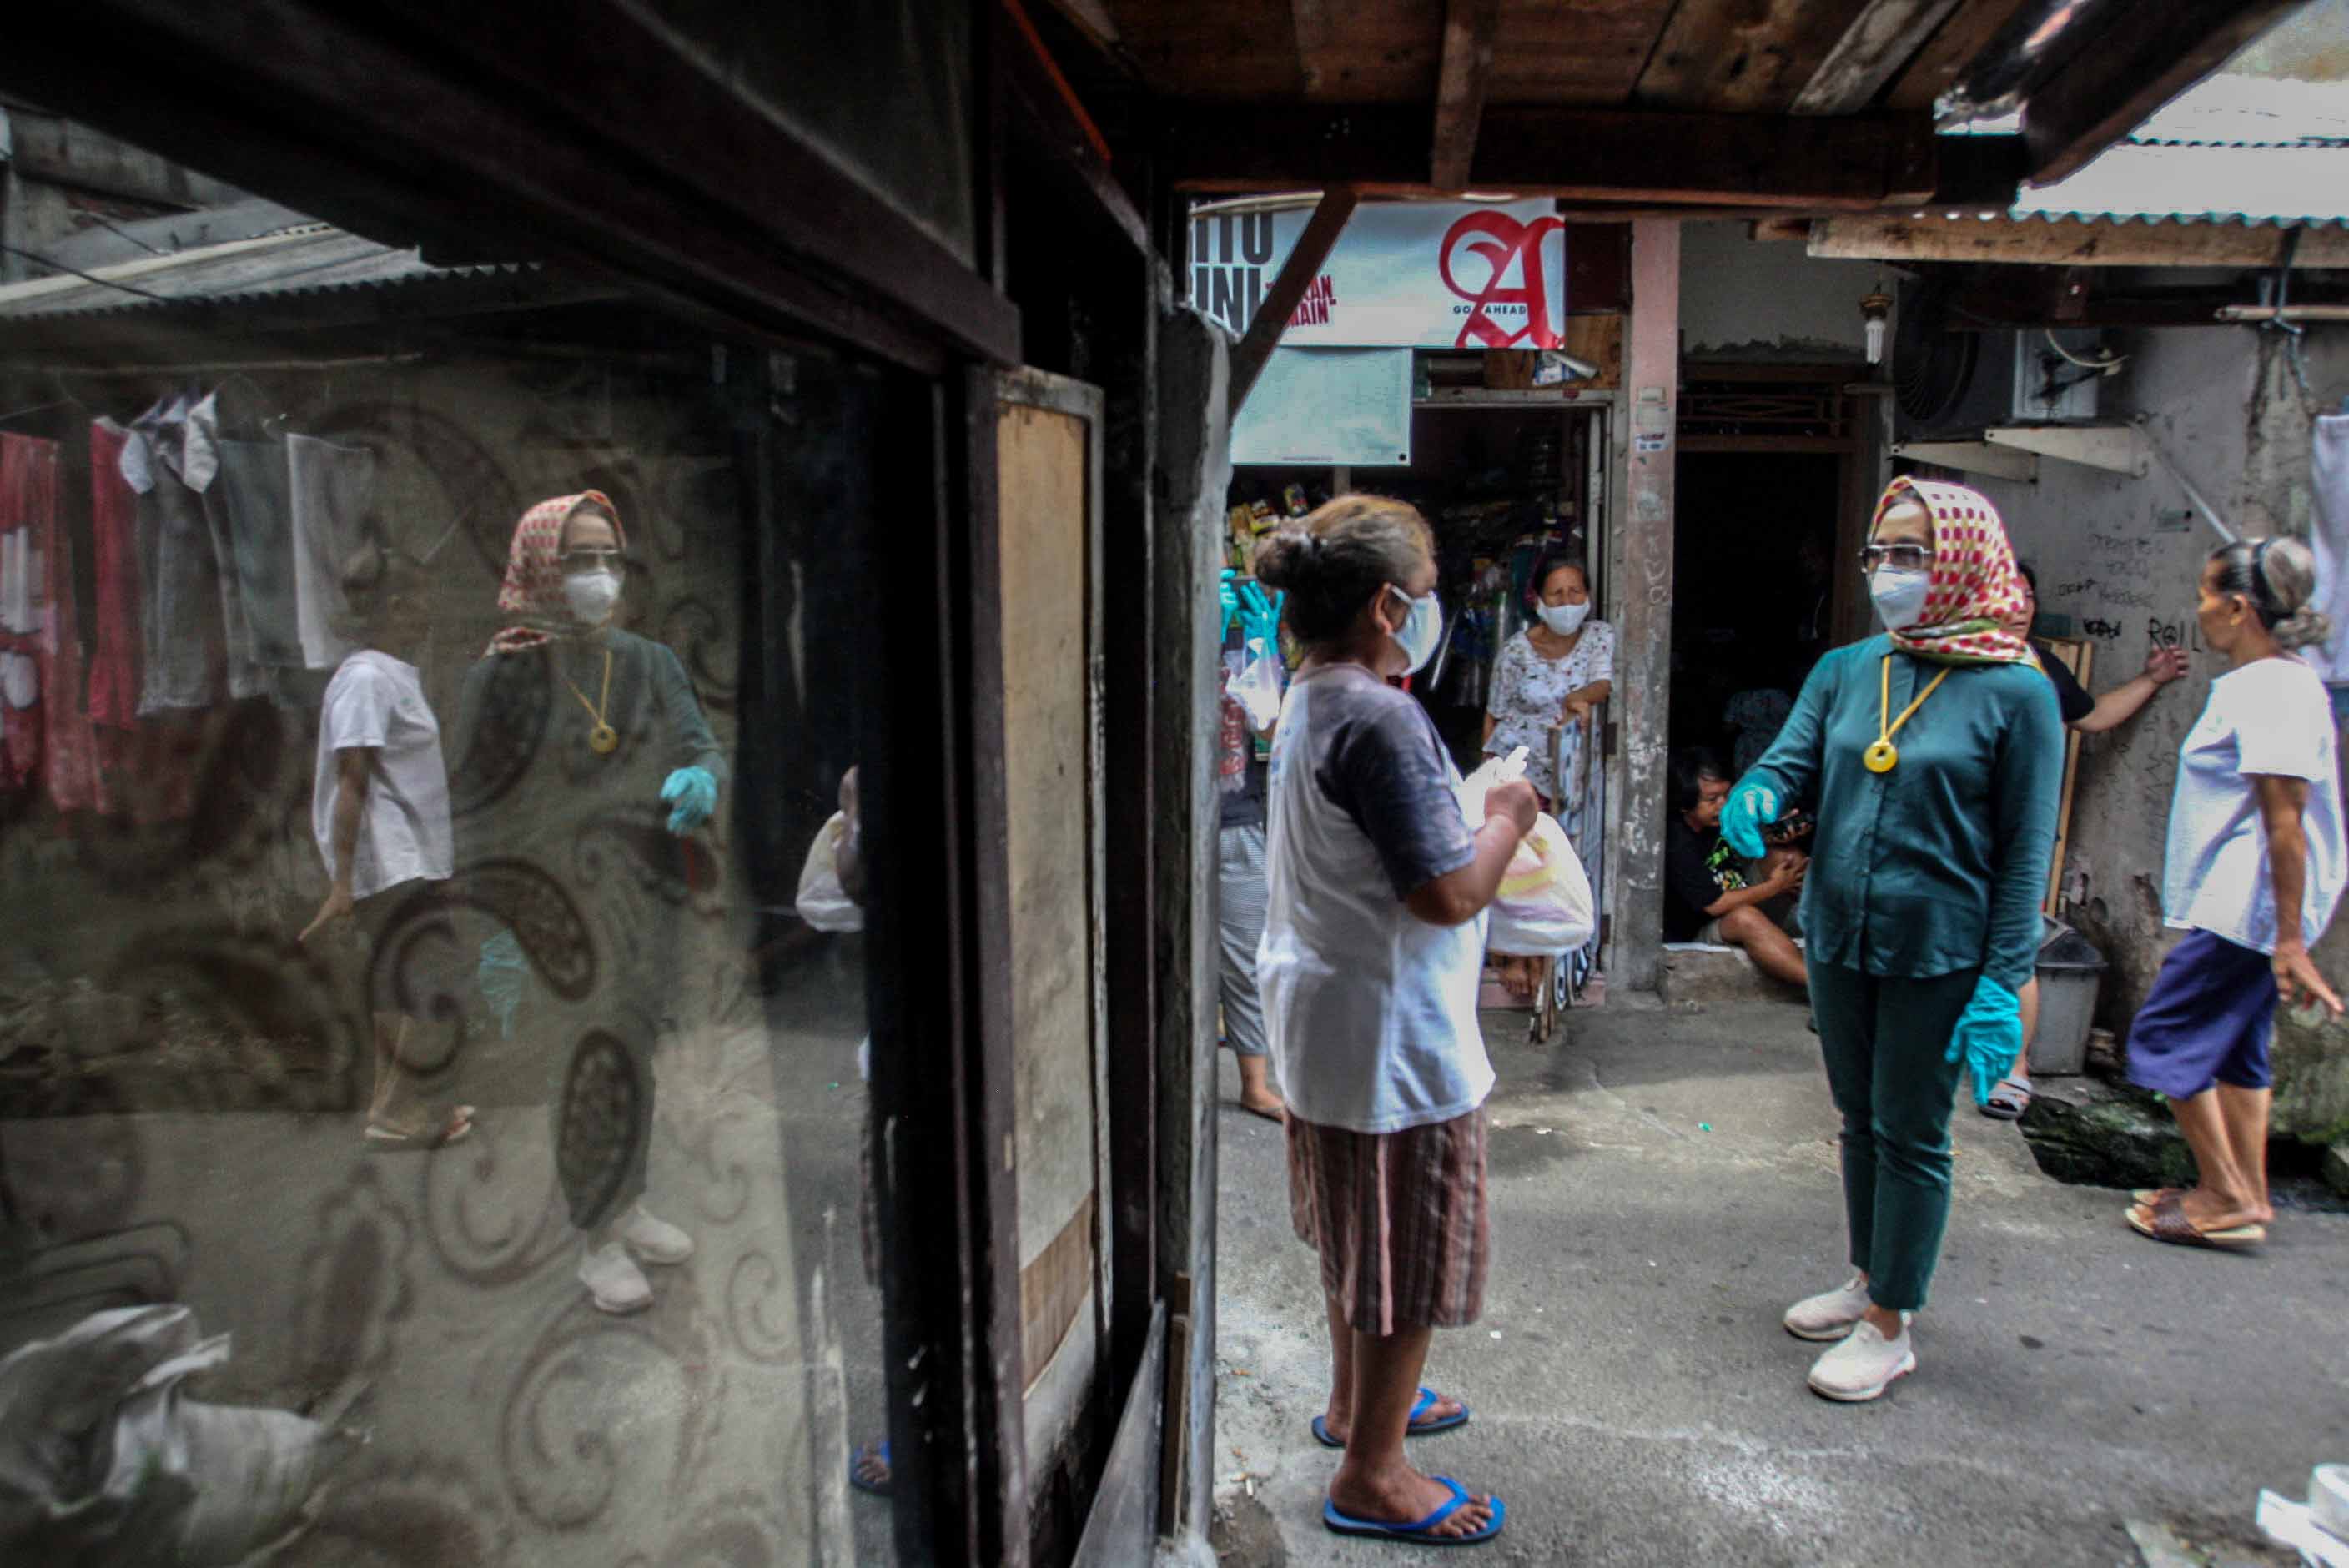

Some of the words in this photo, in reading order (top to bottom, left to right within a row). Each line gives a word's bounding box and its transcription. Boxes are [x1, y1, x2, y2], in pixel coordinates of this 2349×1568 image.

[1189, 211, 1274, 265] ITU
[1453, 305, 1471, 314] GO
[1485, 305, 1527, 314] AHEAD
